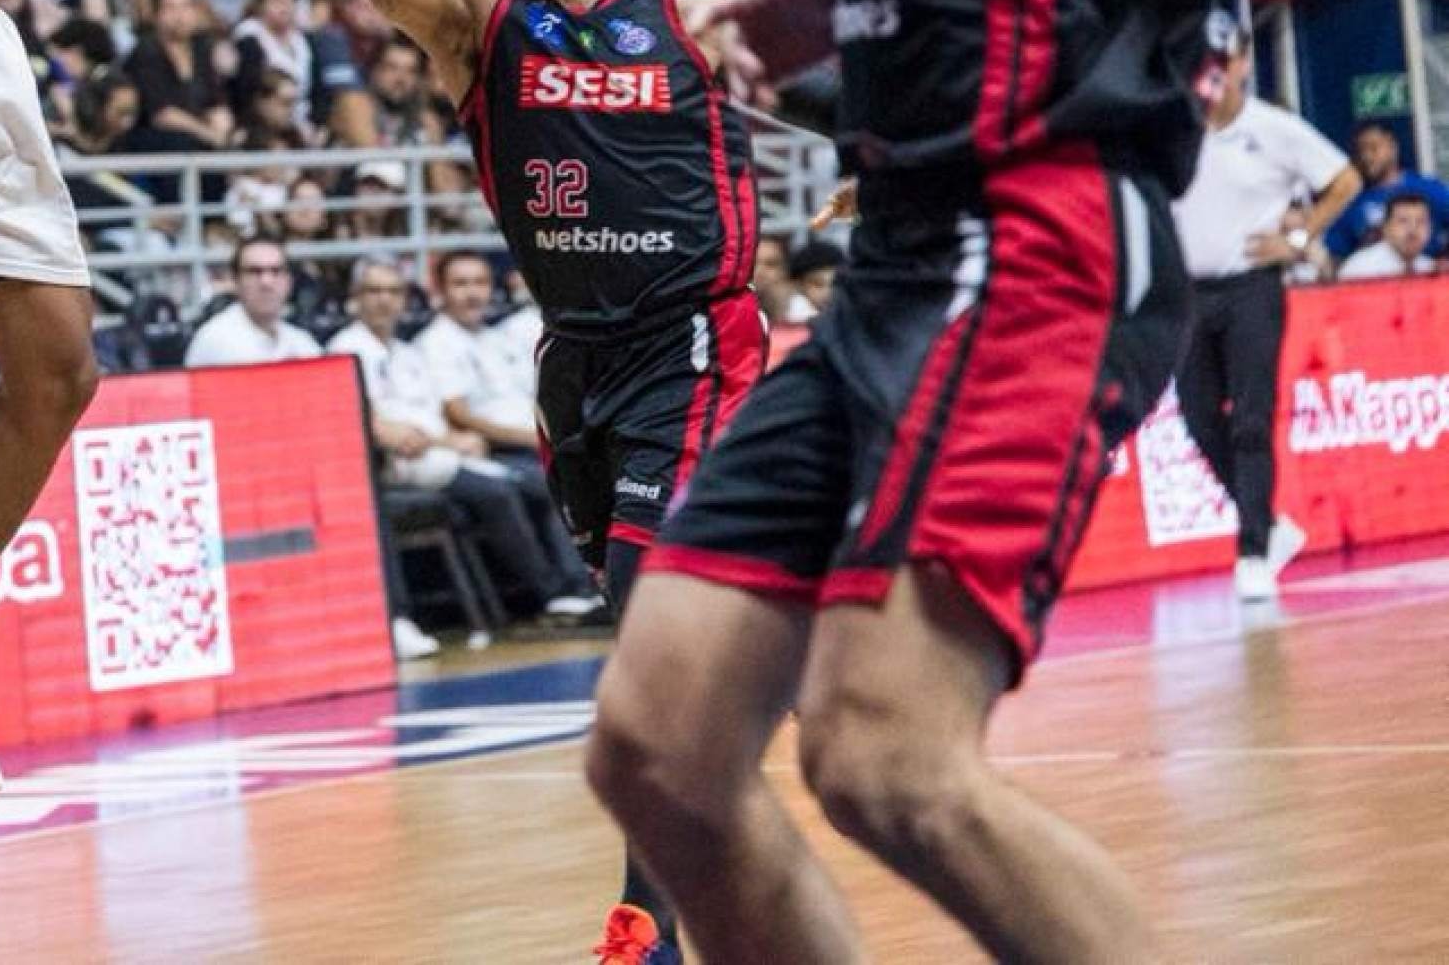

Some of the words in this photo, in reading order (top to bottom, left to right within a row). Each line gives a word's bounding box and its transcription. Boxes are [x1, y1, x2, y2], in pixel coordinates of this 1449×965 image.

[534, 64, 656, 107] SESI
[524, 158, 589, 217] 32
[535, 226, 675, 253] netshoes
